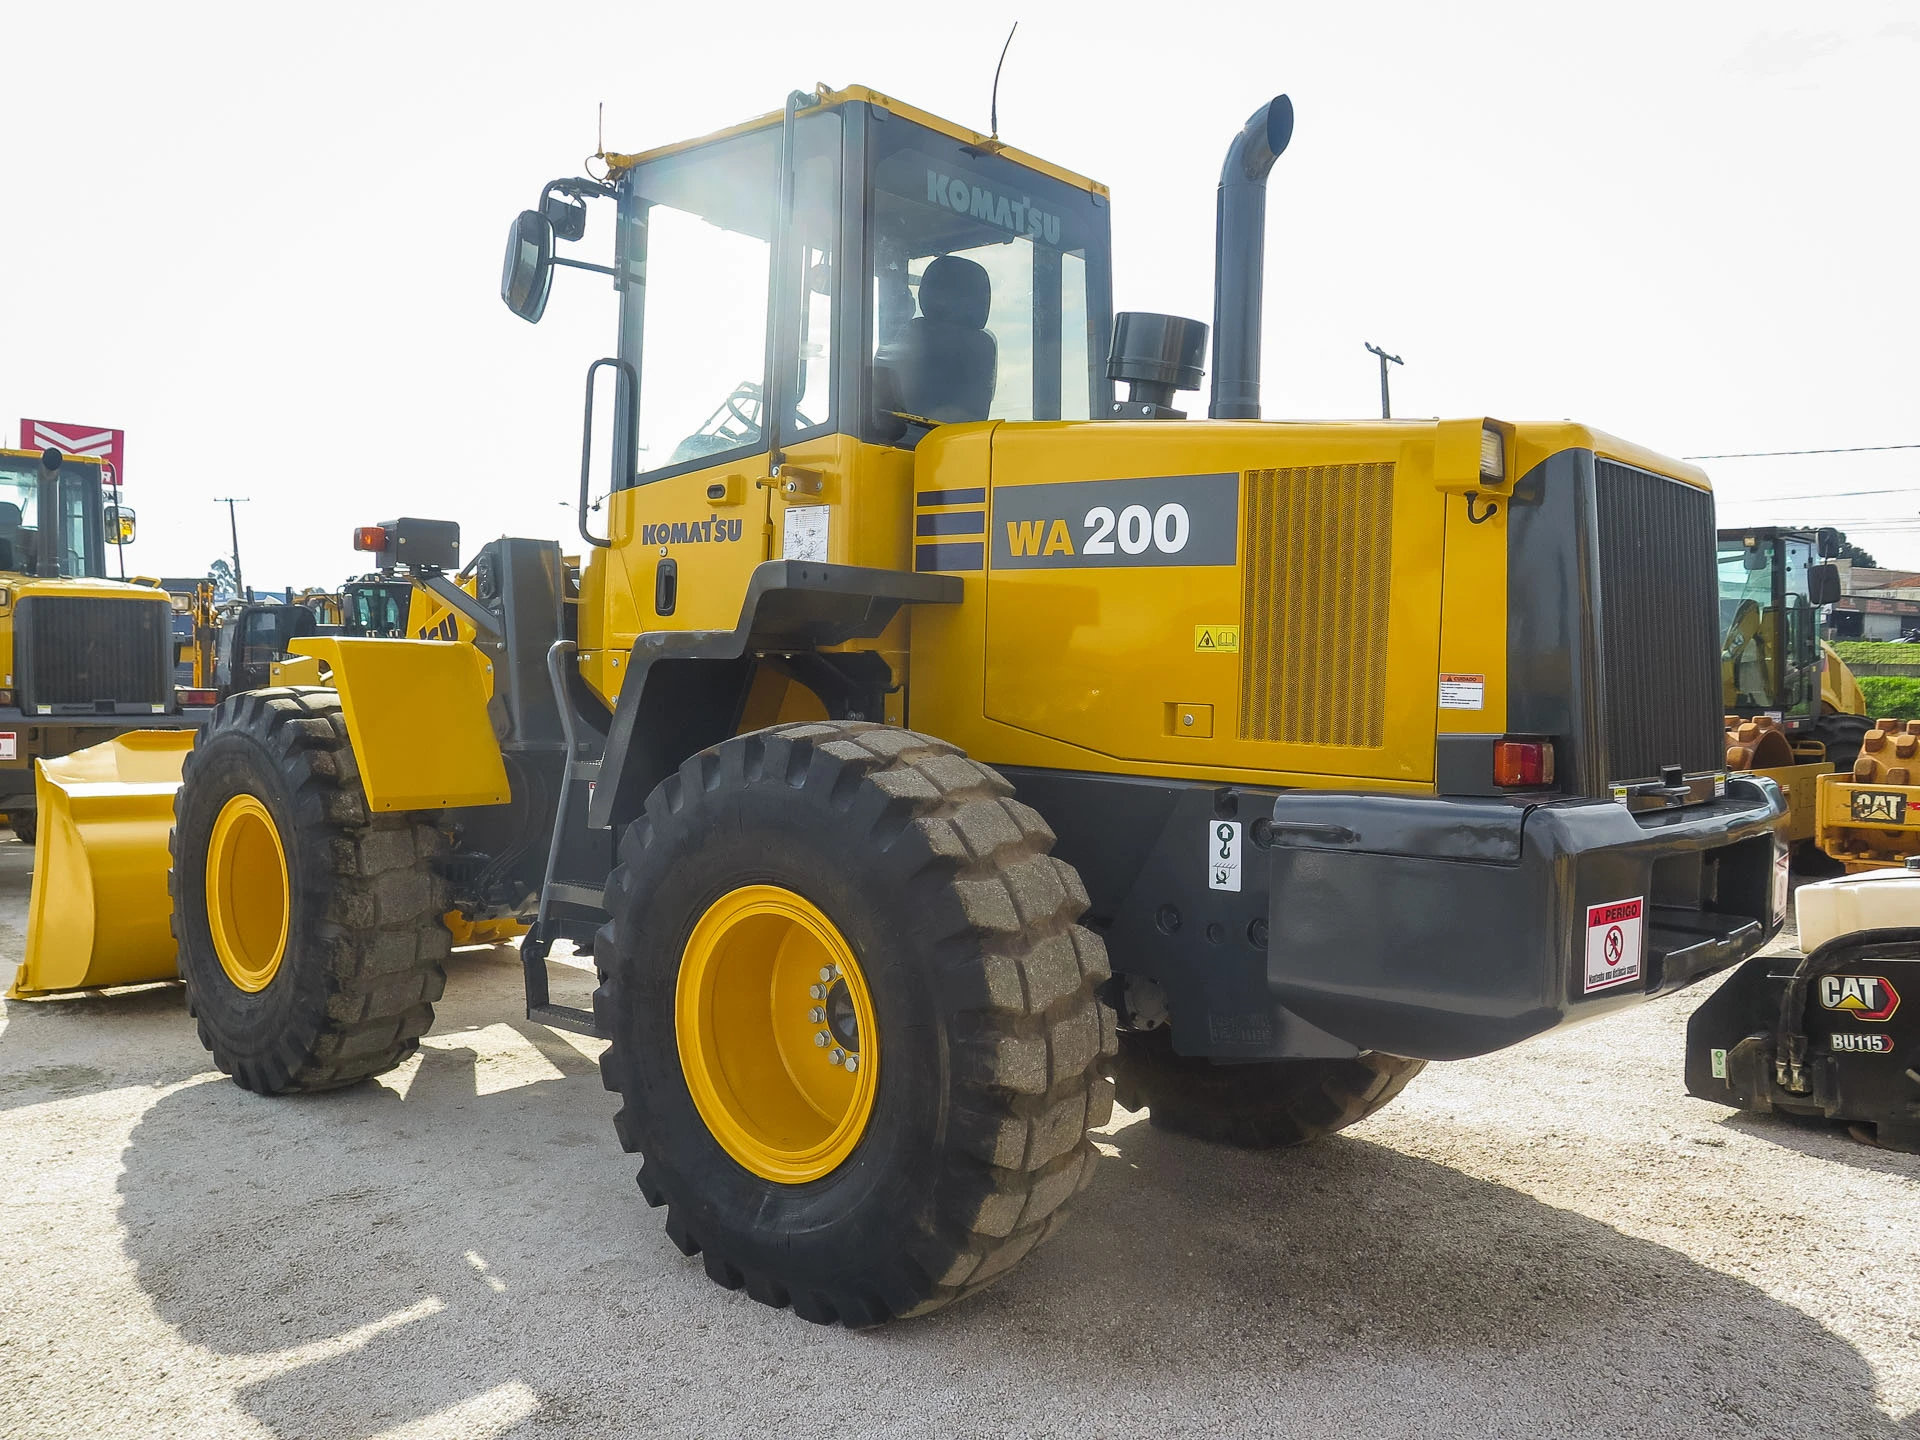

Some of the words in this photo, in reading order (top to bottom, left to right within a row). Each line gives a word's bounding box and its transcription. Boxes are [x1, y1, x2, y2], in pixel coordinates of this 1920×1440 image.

[927, 167, 1061, 245] KOMATSU
[642, 513, 743, 546] KOMATSU
[1006, 519, 1075, 557] WA
[1082, 502, 1190, 555] 200
[1855, 793, 1902, 820] CAT
[1605, 904, 1637, 921] PERIGO
[1821, 976, 1878, 1010] CAT
[1831, 1034, 1883, 1051] BU115
